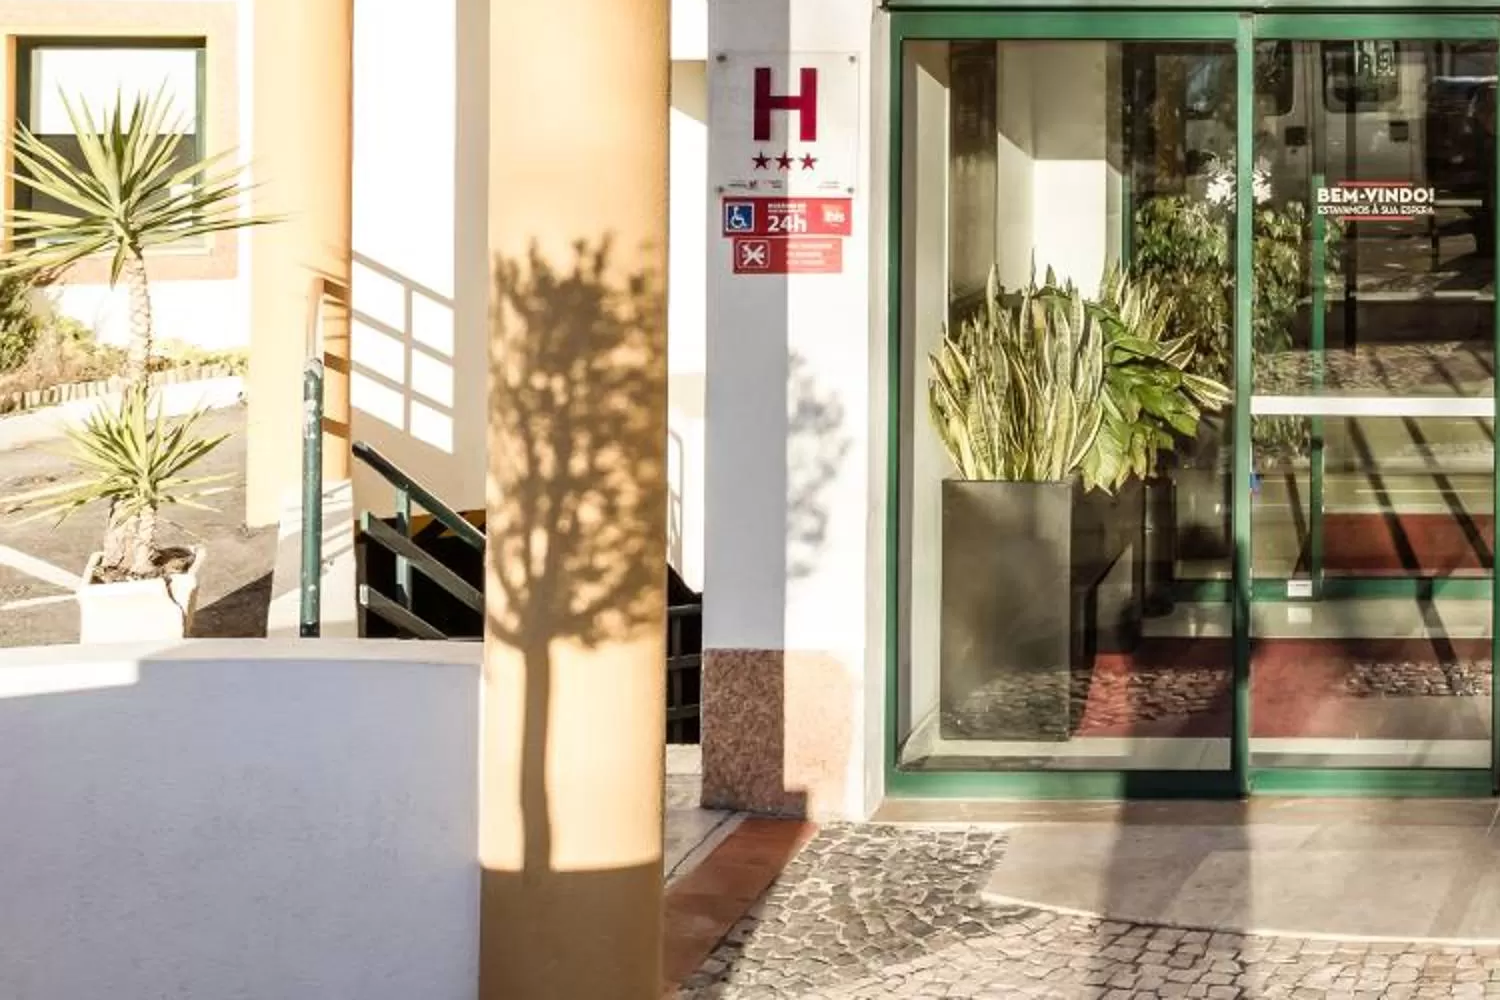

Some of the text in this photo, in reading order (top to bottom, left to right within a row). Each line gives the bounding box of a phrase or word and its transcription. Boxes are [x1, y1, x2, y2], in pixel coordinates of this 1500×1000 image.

[754, 67, 817, 142] H
[1316, 187, 1435, 203] BEM-VINDO!
[1380, 205, 1399, 215] SUA
[1401, 205, 1435, 215] ESPERA
[767, 213, 808, 233] 24h
